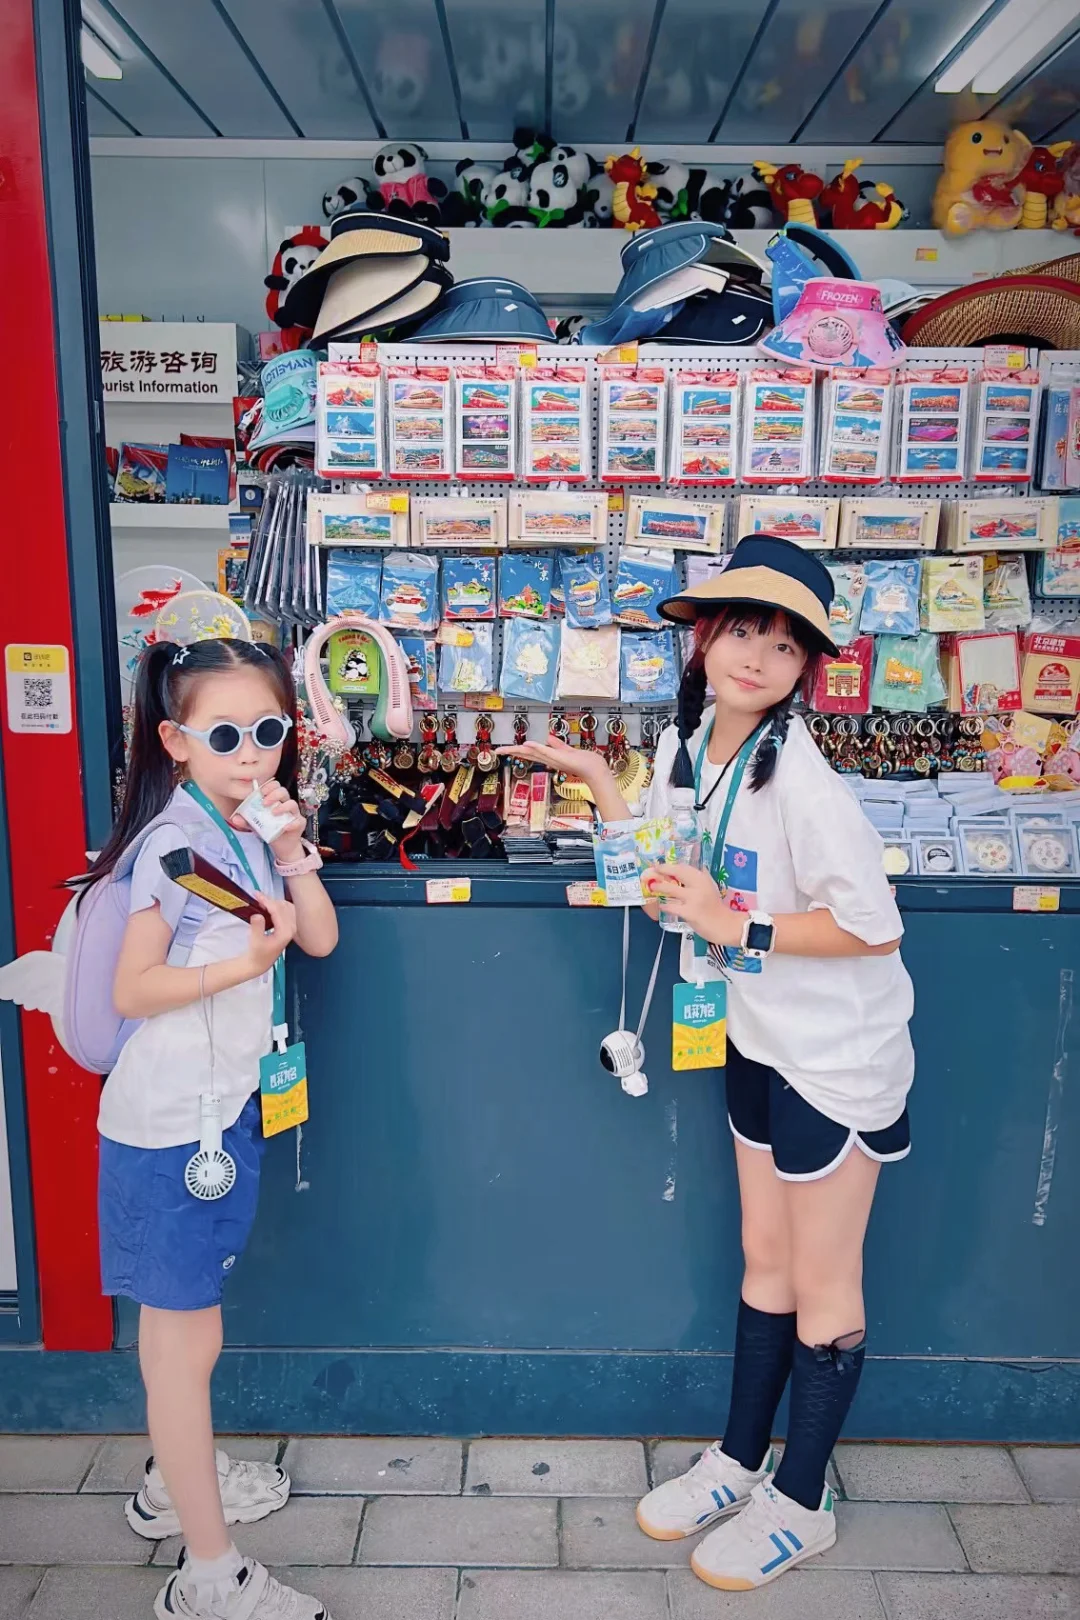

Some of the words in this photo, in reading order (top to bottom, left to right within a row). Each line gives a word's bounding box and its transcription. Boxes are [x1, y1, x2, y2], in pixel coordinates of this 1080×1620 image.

[821, 290, 859, 303] FROZEN
[100, 351, 218, 373] 旅游咨询
[103, 380, 134, 393] urist
[139, 380, 218, 393] Information
[606, 862, 635, 874] 每日坚果
